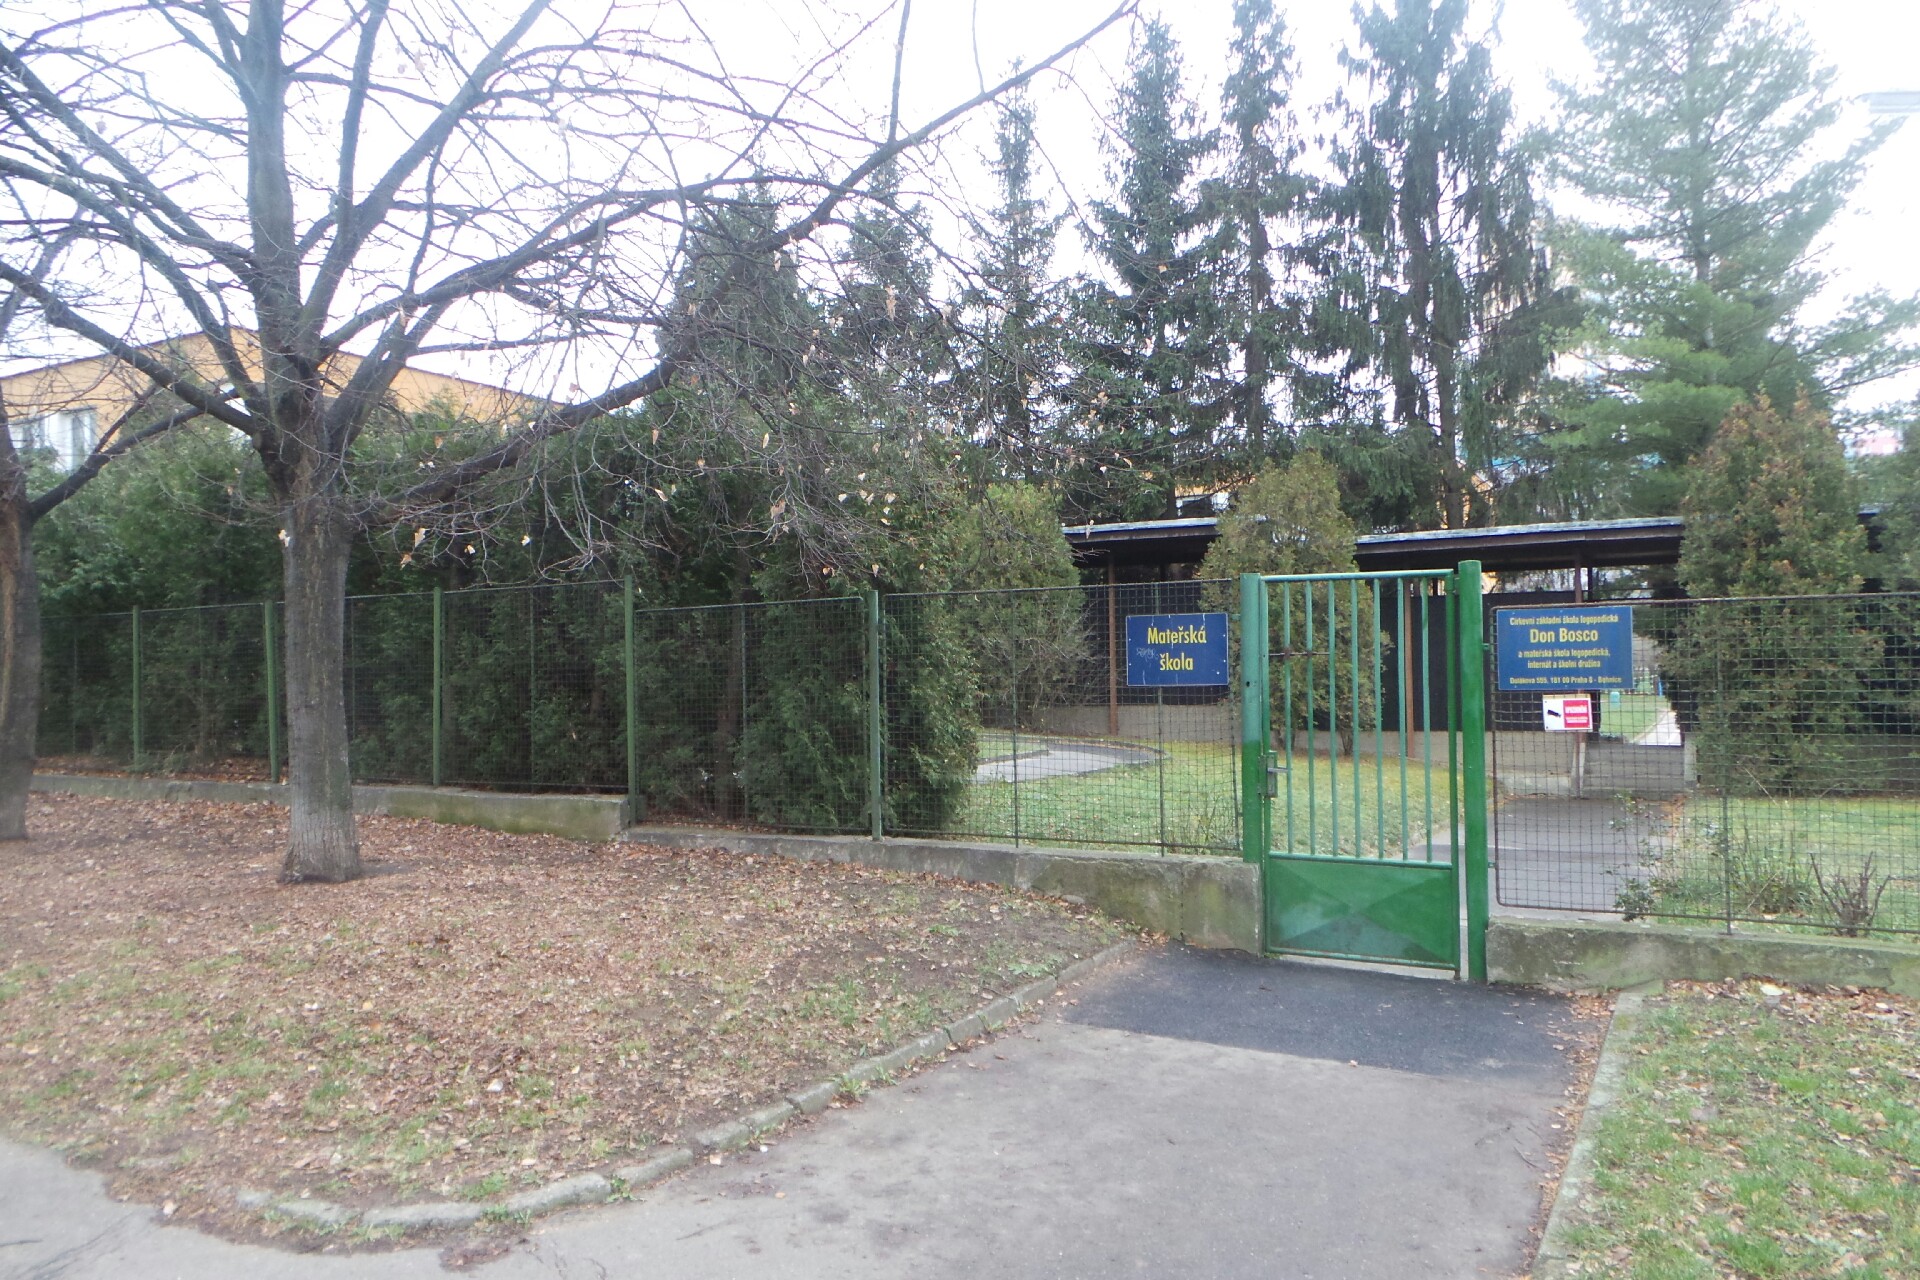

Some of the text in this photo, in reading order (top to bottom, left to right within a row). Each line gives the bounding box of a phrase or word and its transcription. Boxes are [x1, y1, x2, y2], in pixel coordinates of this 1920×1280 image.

[1147, 624, 1207, 645] Mateřská
[1530, 627, 1598, 643] Don Bosco
[1159, 652, 1194, 671] škola
